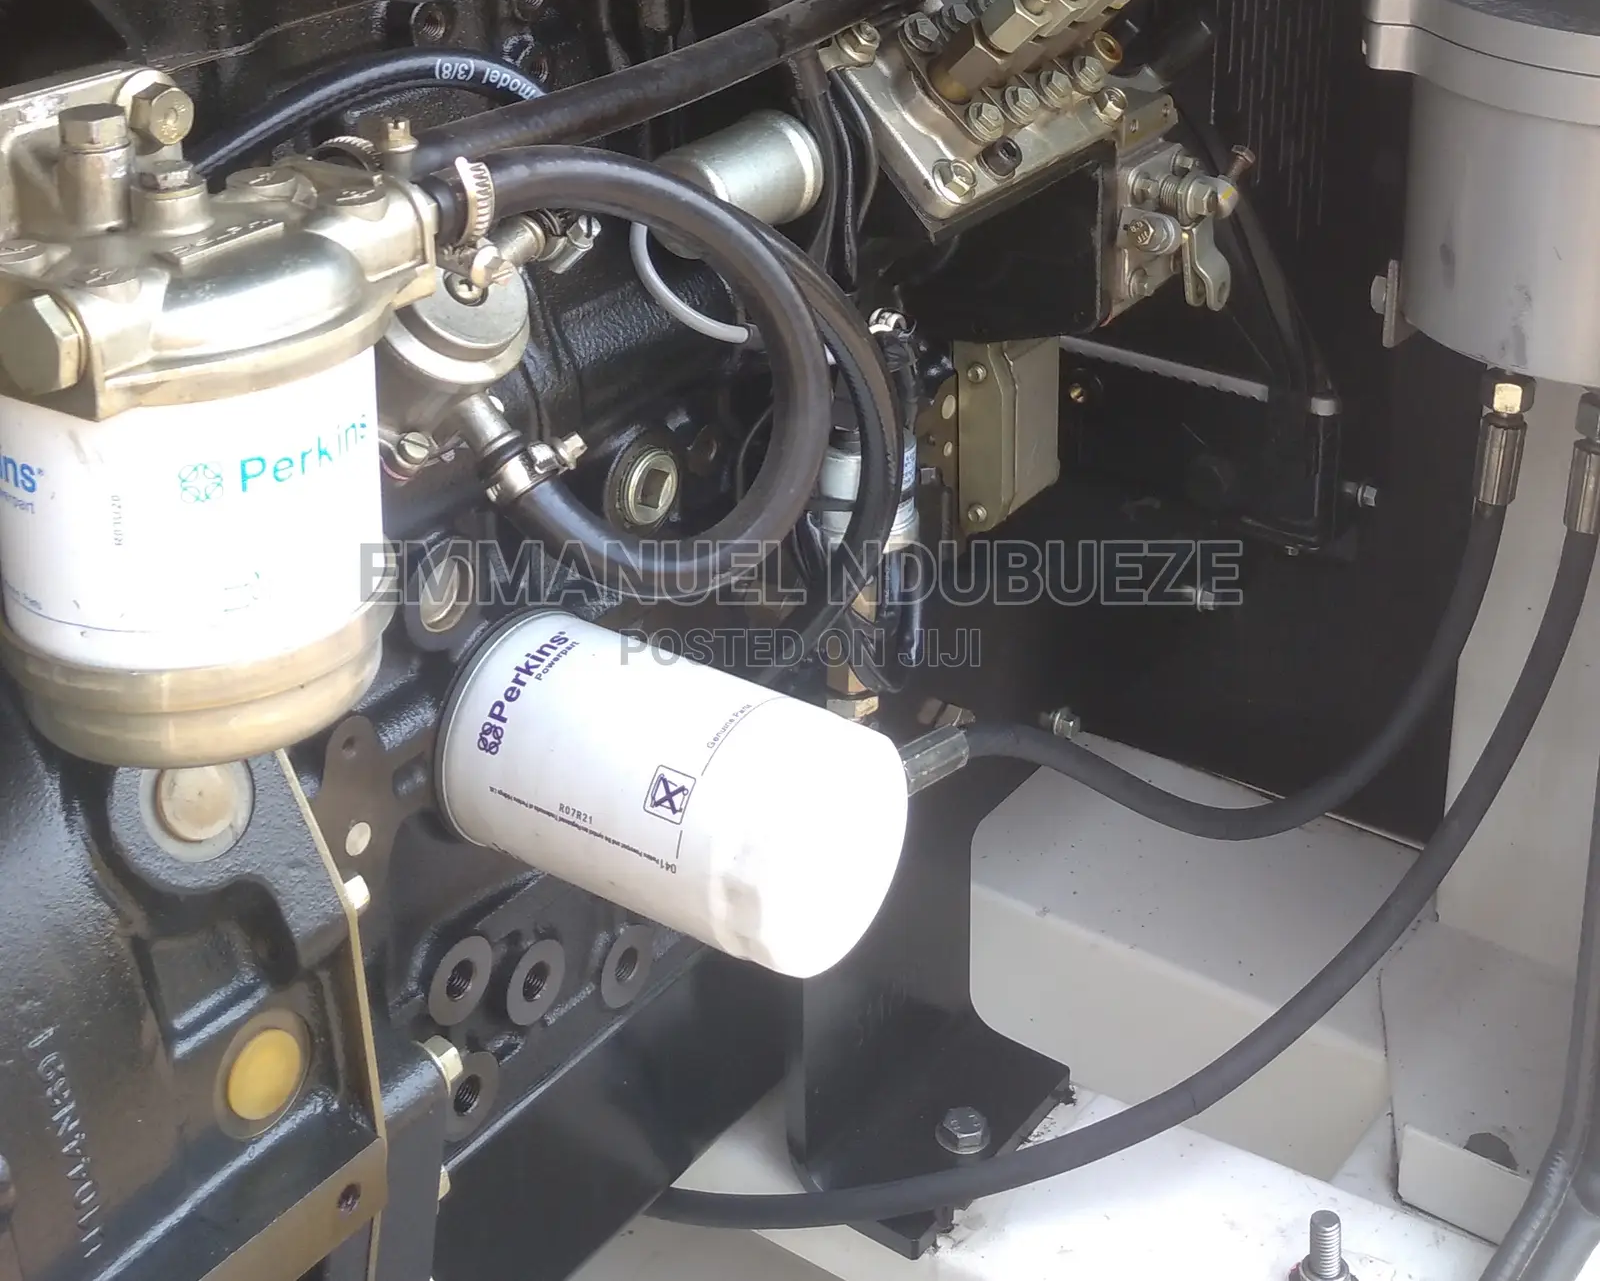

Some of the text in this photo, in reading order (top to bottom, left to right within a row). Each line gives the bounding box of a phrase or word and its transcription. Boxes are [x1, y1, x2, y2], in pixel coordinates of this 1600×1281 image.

[435, 59, 537, 100] model (3/8)
[488, 631, 569, 724] Perkins
[535, 641, 580, 681] Powerpart
[559, 803, 593, 825] R07R21
